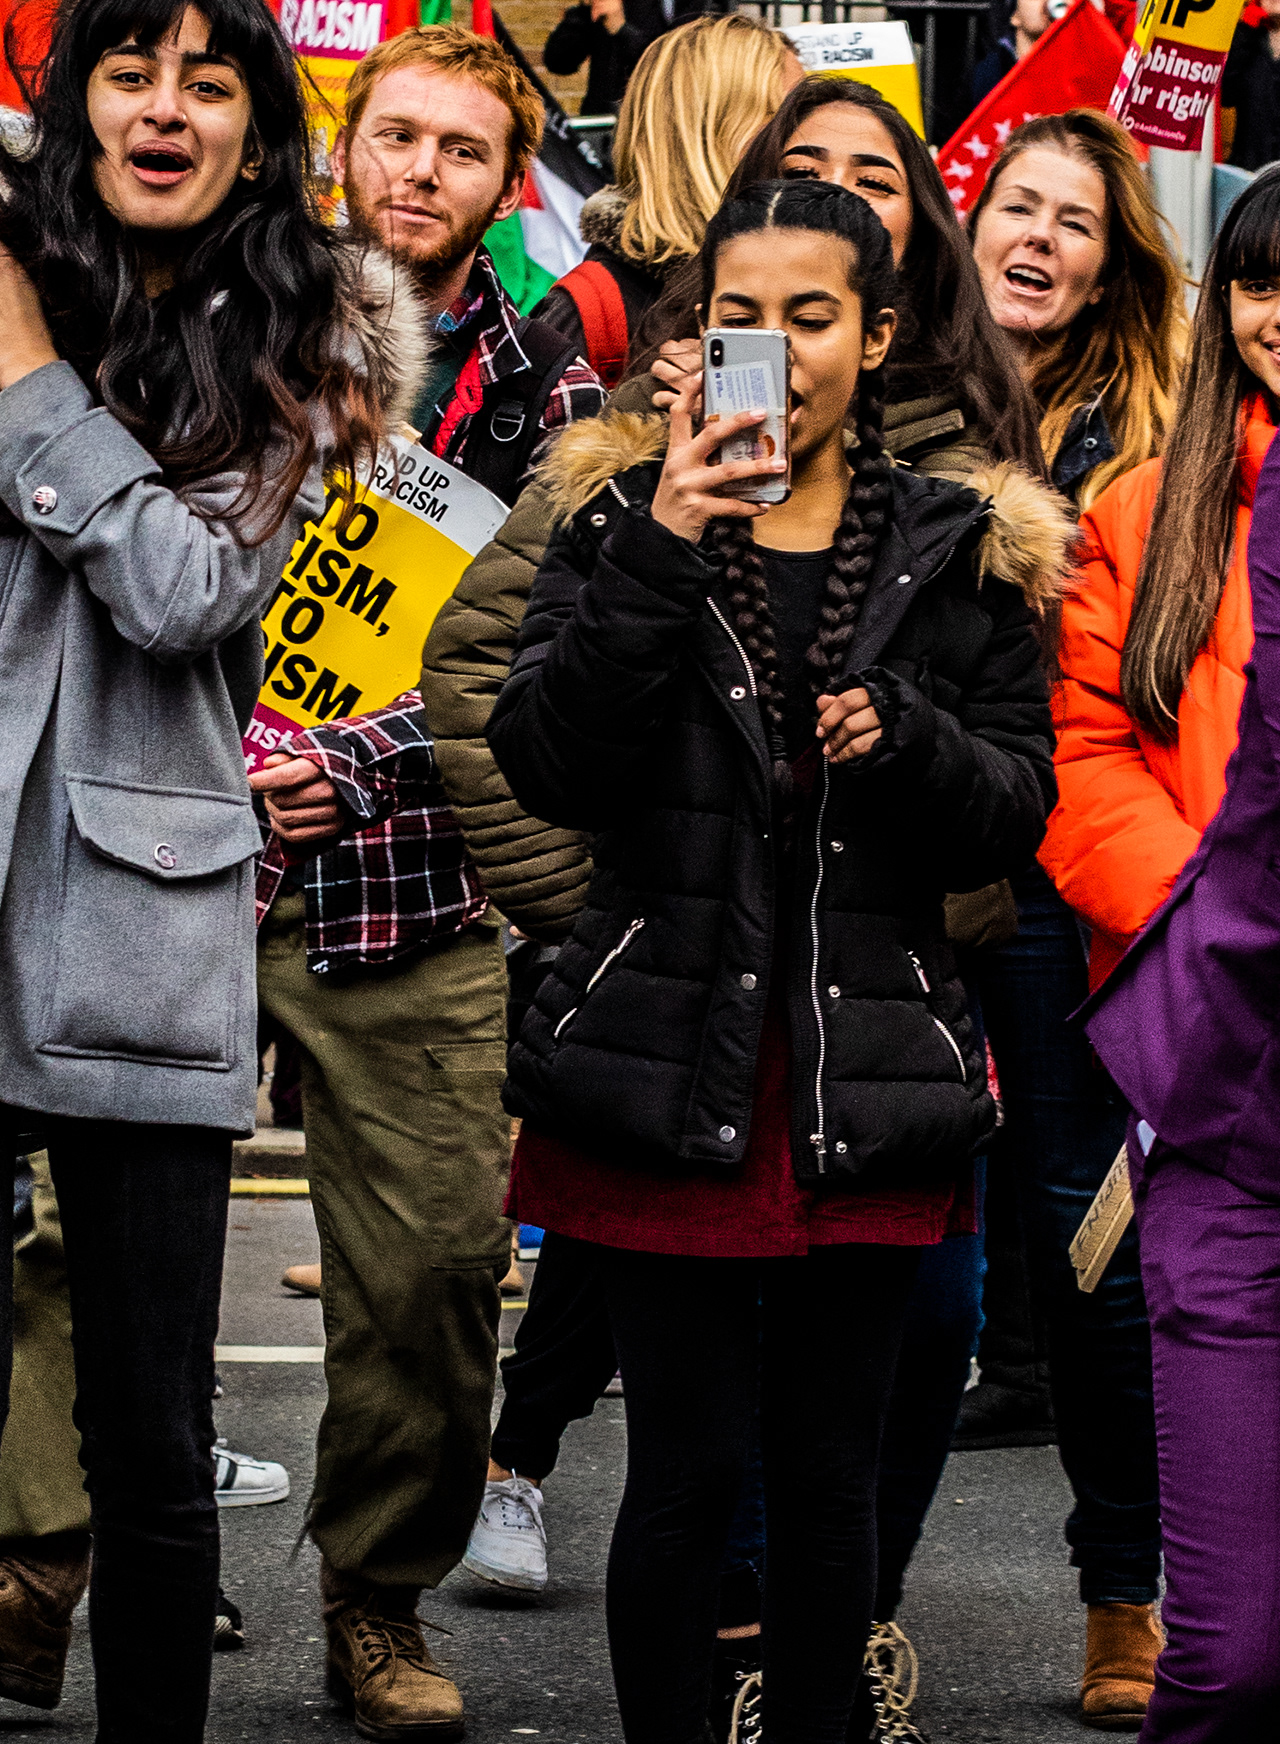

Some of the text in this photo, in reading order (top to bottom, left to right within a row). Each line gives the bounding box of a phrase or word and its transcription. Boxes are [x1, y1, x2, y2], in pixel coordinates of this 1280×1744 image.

[280, 0, 382, 52] RACISM
[370, 464, 451, 524] RACISM
[418, 465, 451, 494] UP
[262, 636, 364, 722] ISM
